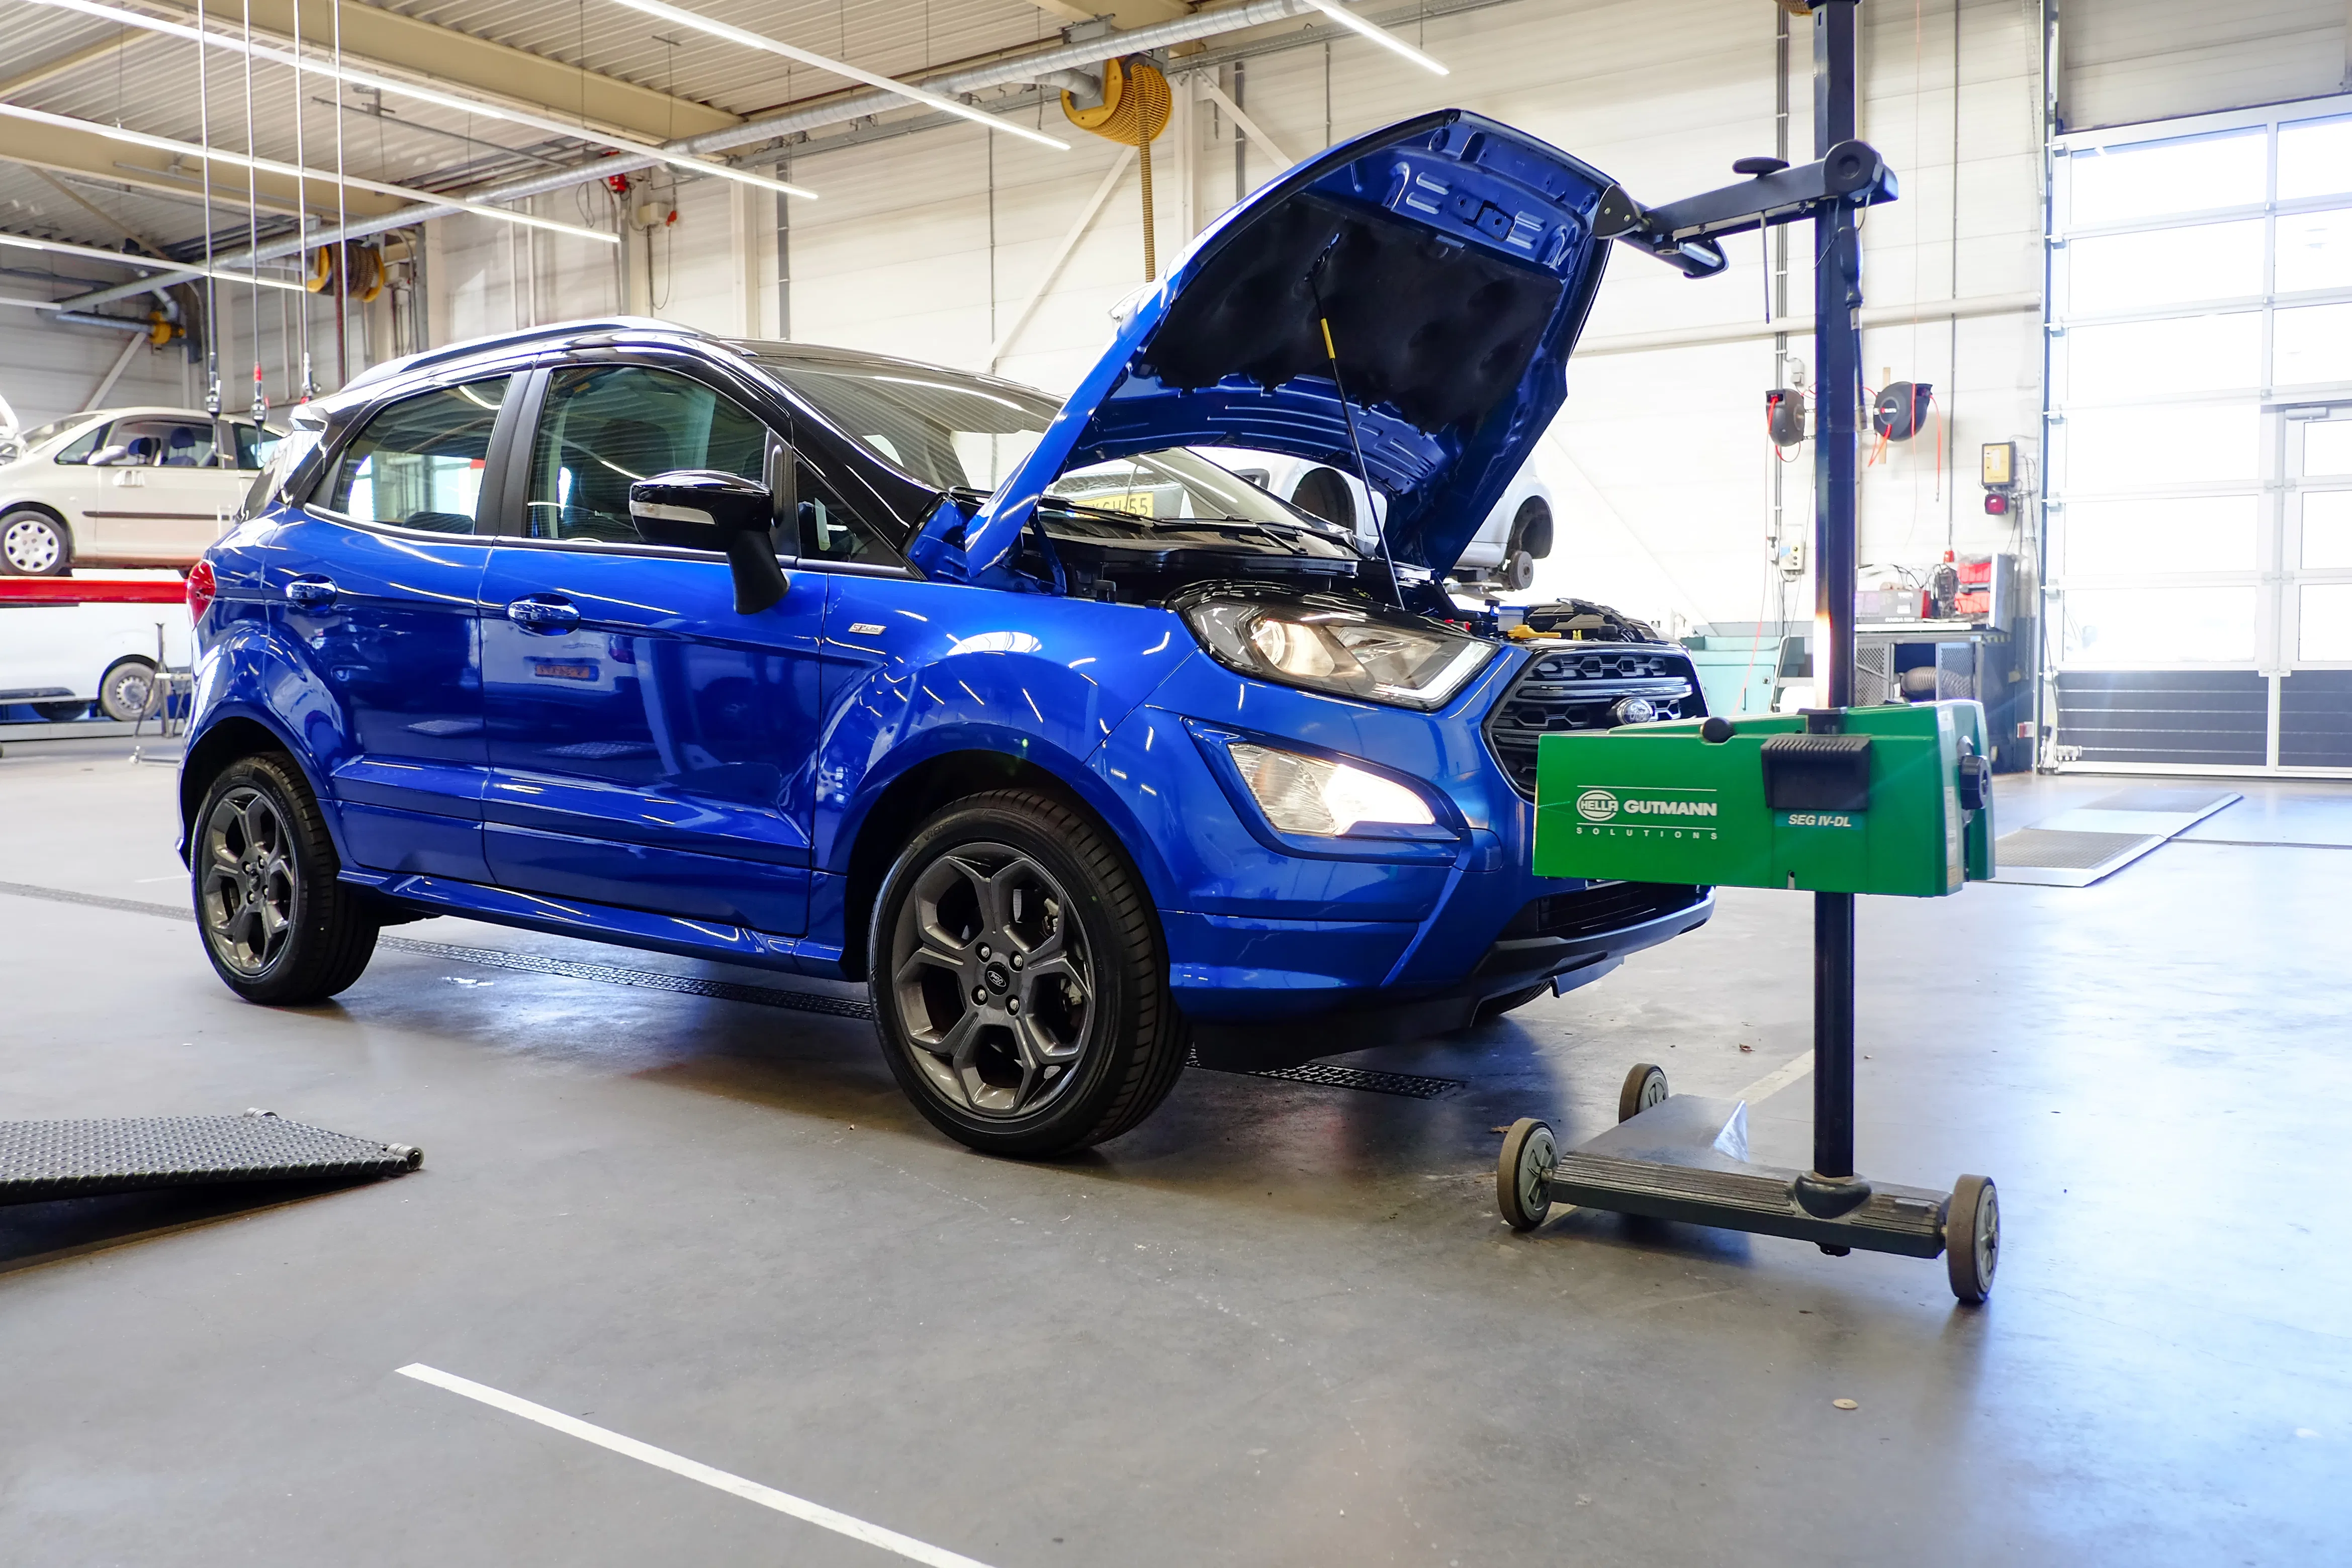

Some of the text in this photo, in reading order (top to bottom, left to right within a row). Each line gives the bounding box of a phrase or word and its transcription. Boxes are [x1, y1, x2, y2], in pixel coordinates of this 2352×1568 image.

[1580, 800, 1717, 816] HELLA GUTMANN
[1788, 814, 1852, 827] SEG IV-DL
[1576, 827, 1717, 840] SOLUTIONS
